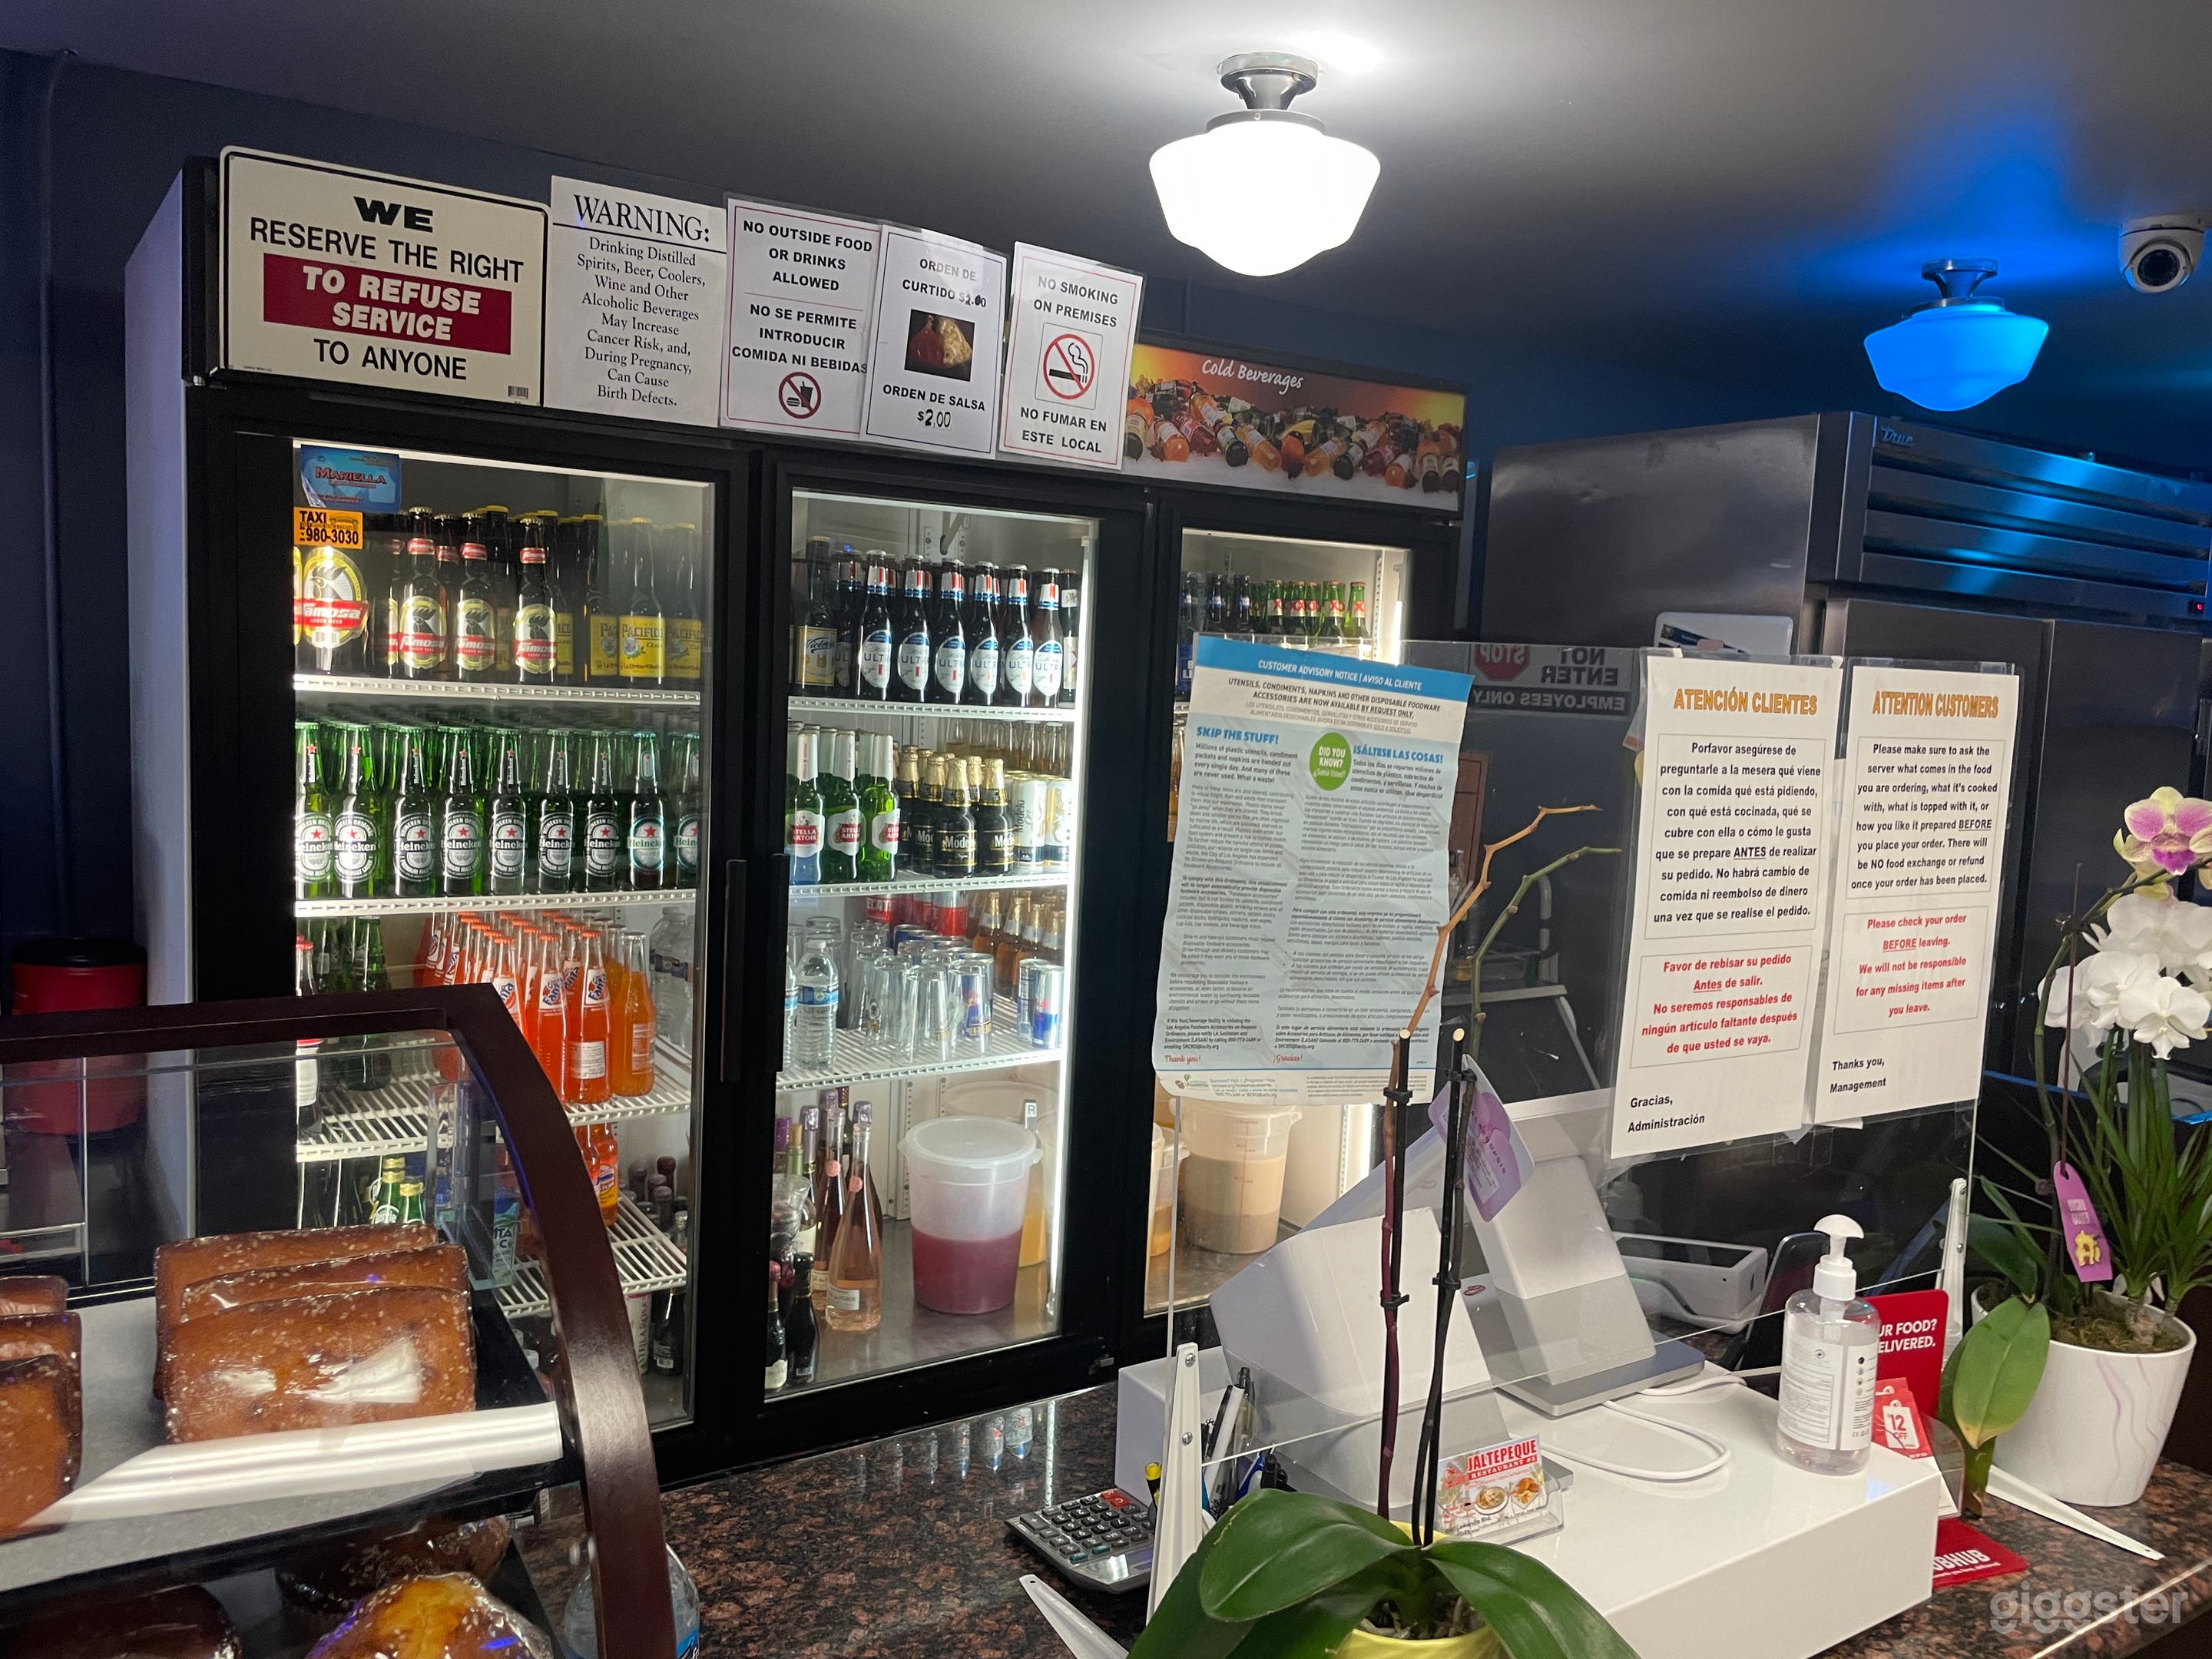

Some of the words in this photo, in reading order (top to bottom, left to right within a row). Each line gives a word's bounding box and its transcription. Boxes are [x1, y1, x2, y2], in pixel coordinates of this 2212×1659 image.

[353, 196, 434, 233] WE
[573, 194, 710, 243] WARNING:
[743, 220, 764, 233] NO
[769, 224, 831, 246] OUTSIDE
[835, 236, 873, 252] FOOD
[250, 216, 376, 260] RESERVE
[388, 239, 438, 270] THE
[450, 250, 525, 283] RIGHT
[589, 236, 644, 260] Drinking
[647, 246, 697, 267] Distilled
[768, 247, 789, 261] OR
[793, 251, 846, 270] DRINKS
[577, 253, 620, 274] Spirits,
[624, 260, 654, 280] Beer,
[657, 267, 706, 287] Coolers,
[772, 270, 839, 291] ALLOWED
[919, 258, 959, 277] ORDEN
[962, 269, 977, 282] DE
[303, 265, 346, 294] TO
[359, 274, 482, 315] REFUSE
[594, 274, 626, 292] Wine
[629, 282, 651, 296] and
[654, 284, 689, 301] Other
[902, 279, 955, 300] CURTIDO
[1038, 276, 1056, 290] NO
[1060, 281, 1118, 305] SMOKING
[581, 291, 639, 312] Alcoholic
[643, 300, 699, 322] Beverages
[750, 303, 770, 316] NO
[774, 307, 793, 320] SE
[796, 310, 857, 330] PERMITE
[1033, 299, 1052, 313] ON
[1055, 303, 1118, 328] PREMISES
[332, 301, 453, 341] SERVICE
[601, 312, 628, 331] May
[632, 316, 680, 336] Increase
[587, 329, 631, 347] Cancer
[634, 334, 664, 353] Risk,
[667, 342, 690, 357] and,
[760, 327, 846, 350] INTRODUCIR
[313, 338, 349, 365] TO
[361, 345, 467, 381] ANYONE
[584, 346, 628, 367] During
[631, 353, 692, 376] Pregnancy,
[731, 346, 788, 364] COMIDA
[792, 353, 806, 366] NI
[810, 356, 868, 374] BEBIDAS
[608, 368, 631, 383] Can
[634, 371, 669, 388] Cause
[1202, 358, 1234, 378] Cold
[1237, 364, 1304, 394] Beverages
[598, 384, 628, 400] Birth
[631, 388, 677, 406] Defects.
[882, 384, 926, 401] ORDEN
[929, 392, 945, 405] DE
[949, 396, 985, 412] SALSA
[916, 409, 952, 429] $2.00
[1020, 406, 1039, 420] NO
[1042, 410, 1087, 429] FUMAR
[1090, 419, 1107, 432] EN
[1022, 429, 1055, 445] ESTE
[1061, 436, 1102, 453] LOCAL
[300, 510, 327, 524] TAXI
[306, 528, 359, 545] 980-3030
[1258, 659, 1298, 674] CUSTOMER
[1297, 664, 1334, 678] ADVISORY
[1334, 670, 1359, 682] NOTICE
[1362, 674, 1384, 685] AVISO
[1383, 677, 1393, 687] AL
[1394, 678, 1422, 691] CLIENTE
[1228, 677, 1261, 690] UTENSILS,
[1262, 682, 1307, 695] CONDIMENTS,
[1308, 687, 1337, 698] NAPKINS
[1336, 691, 1350, 700] AND
[1350, 693, 1370, 703] OTHER
[1370, 696, 1408, 708] DISPOSABLE
[1407, 700, 1441, 712] FOODWARE
[1253, 691, 1298, 704] ACCESSORIES
[1299, 697, 1312, 705] ARE
[1313, 699, 1330, 707] NOW
[1330, 700, 1360, 712] AVAILABLE
[1370, 706, 1397, 716] REQUEST
[1673, 686, 1748, 712] ATENCIÓN
[1752, 691, 1818, 715] CLIENTES
[1873, 690, 1933, 717] ATTENTION
[1935, 694, 1999, 719] CUSTOMERS
[1196, 727, 1222, 739] SKIP
[1224, 729, 1242, 741] THE
[1243, 731, 1280, 745] STUFF!
[1319, 746, 1330, 757] DID
[1332, 747, 1346, 759] YOU
[1353, 743, 1392, 759] ¡SÁLTESE
[1392, 750, 1410, 760] LAS
[1411, 751, 1444, 764] COSAS!
[1691, 742, 1734, 754] Porfavor
[1735, 743, 1783, 757] asegúrese
[1785, 744, 1796, 756] de
[1319, 757, 1343, 768] KNOW?
[1867, 919, 1896, 929] Please
[1897, 916, 1923, 927] check
[1924, 916, 1944, 929] your
[1945, 913, 1967, 924] order
[1882, 938, 1918, 953] BEFORE
[1918, 936, 1951, 949] leaving.
[1663, 962, 1693, 973] Favor
[1694, 959, 1707, 971] de
[1710, 958, 1745, 969] rebisar
[1747, 958, 1758, 967] su
[1760, 953, 1792, 969] pedido
[1693, 979, 1723, 991] Antes
[1724, 977, 1737, 988] de
[1739, 975, 1763, 987] salir.
[1832, 1058, 1864, 1071] Thanks
[1866, 1058, 1885, 1070] you,
[1830, 1077, 1886, 1094] Management
[1630, 1094, 1673, 1108] Gracias,
[1627, 1113, 1705, 1133] Administración
[1896, 1319, 1938, 1335] FOOD?
[1878, 1336, 1936, 1354] ELIVERED.
[1468, 1439, 1537, 1472] JALTEPEQUE
[1471, 1459, 1525, 1479] RESTAURANT
